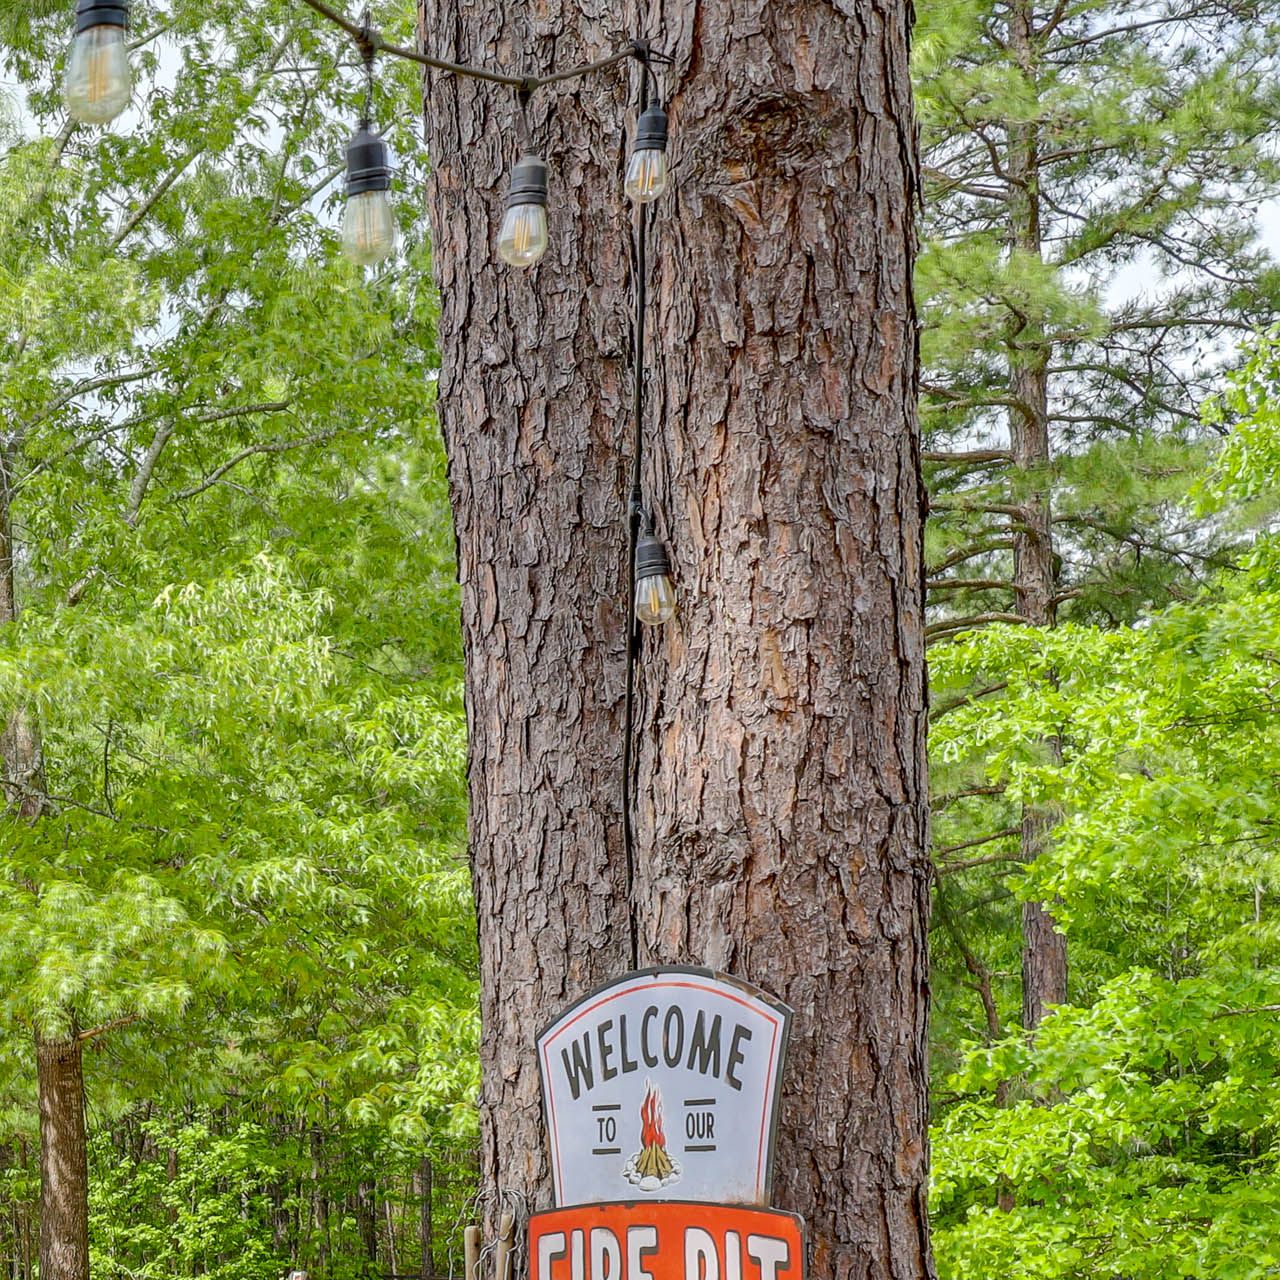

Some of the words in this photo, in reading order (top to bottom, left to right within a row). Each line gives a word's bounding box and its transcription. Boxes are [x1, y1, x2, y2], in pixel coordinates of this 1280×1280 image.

[561, 1004, 752, 1100] WELCOME
[597, 1117, 617, 1143] TO
[685, 1112, 715, 1140] OUR
